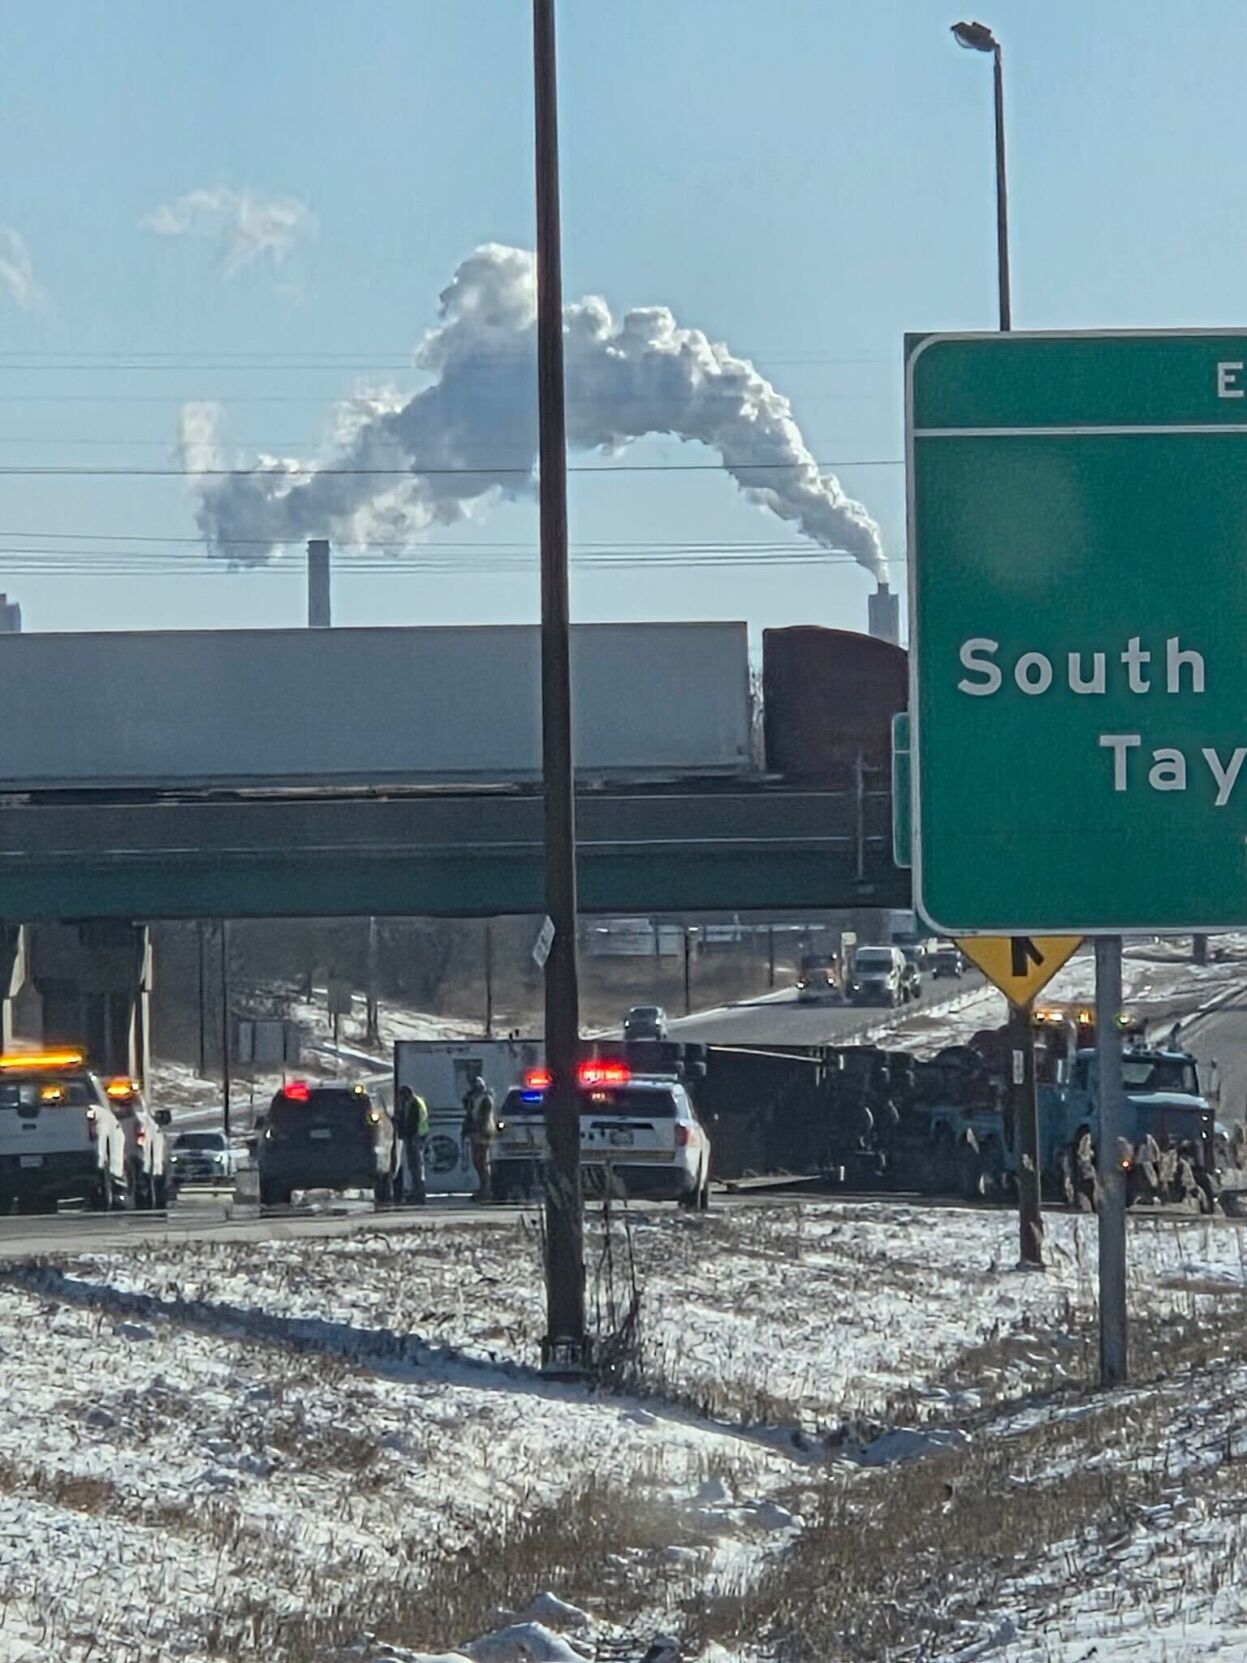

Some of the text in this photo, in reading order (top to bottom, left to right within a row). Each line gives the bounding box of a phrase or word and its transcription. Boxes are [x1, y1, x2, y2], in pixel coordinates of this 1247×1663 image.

[1217, 361, 1244, 398] E
[957, 636, 1206, 697] South
[1099, 734, 1247, 807] Tay
